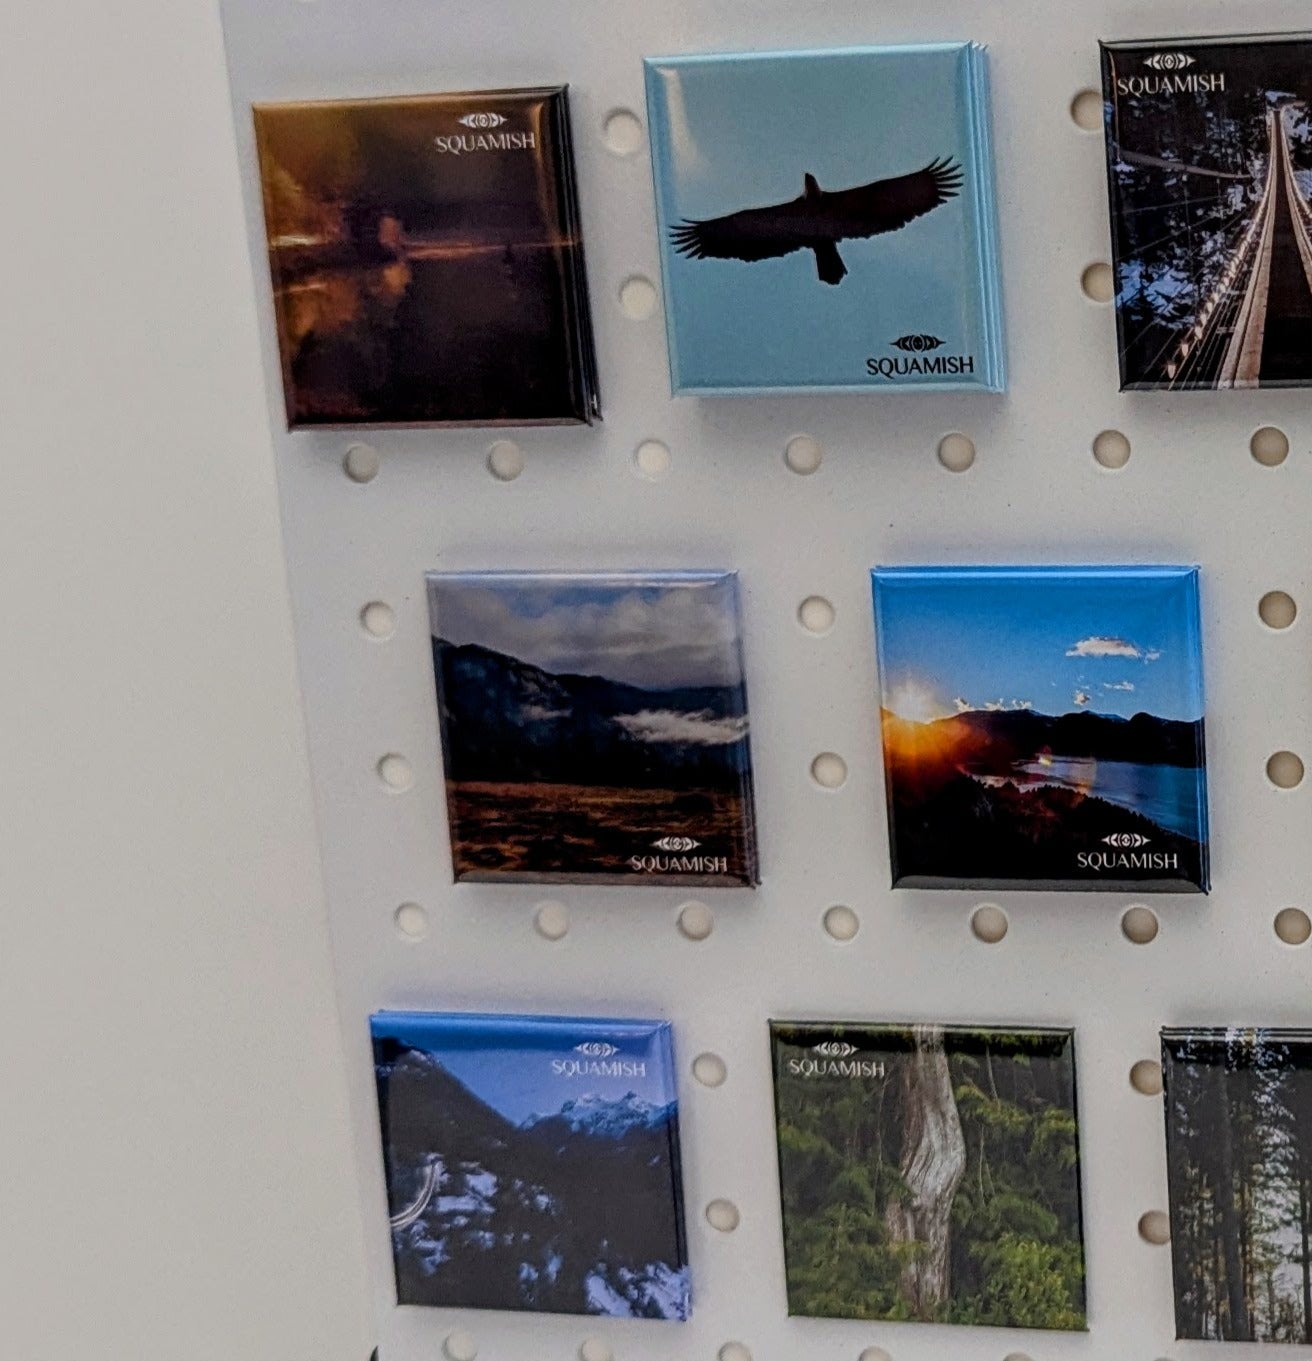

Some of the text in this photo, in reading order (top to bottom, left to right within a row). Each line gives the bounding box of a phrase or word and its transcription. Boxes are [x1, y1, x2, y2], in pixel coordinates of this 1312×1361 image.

[1117, 74, 1225, 96] SQUAMISH
[436, 132, 536, 153] SQUAMISH
[866, 357, 974, 378] SQUAMISH
[631, 855, 727, 873] SQUAMISH
[1077, 851, 1178, 870] SQUAMISH
[551, 1058, 646, 1078] SQUAMISH
[789, 1058, 884, 1078] SQUAMISH
